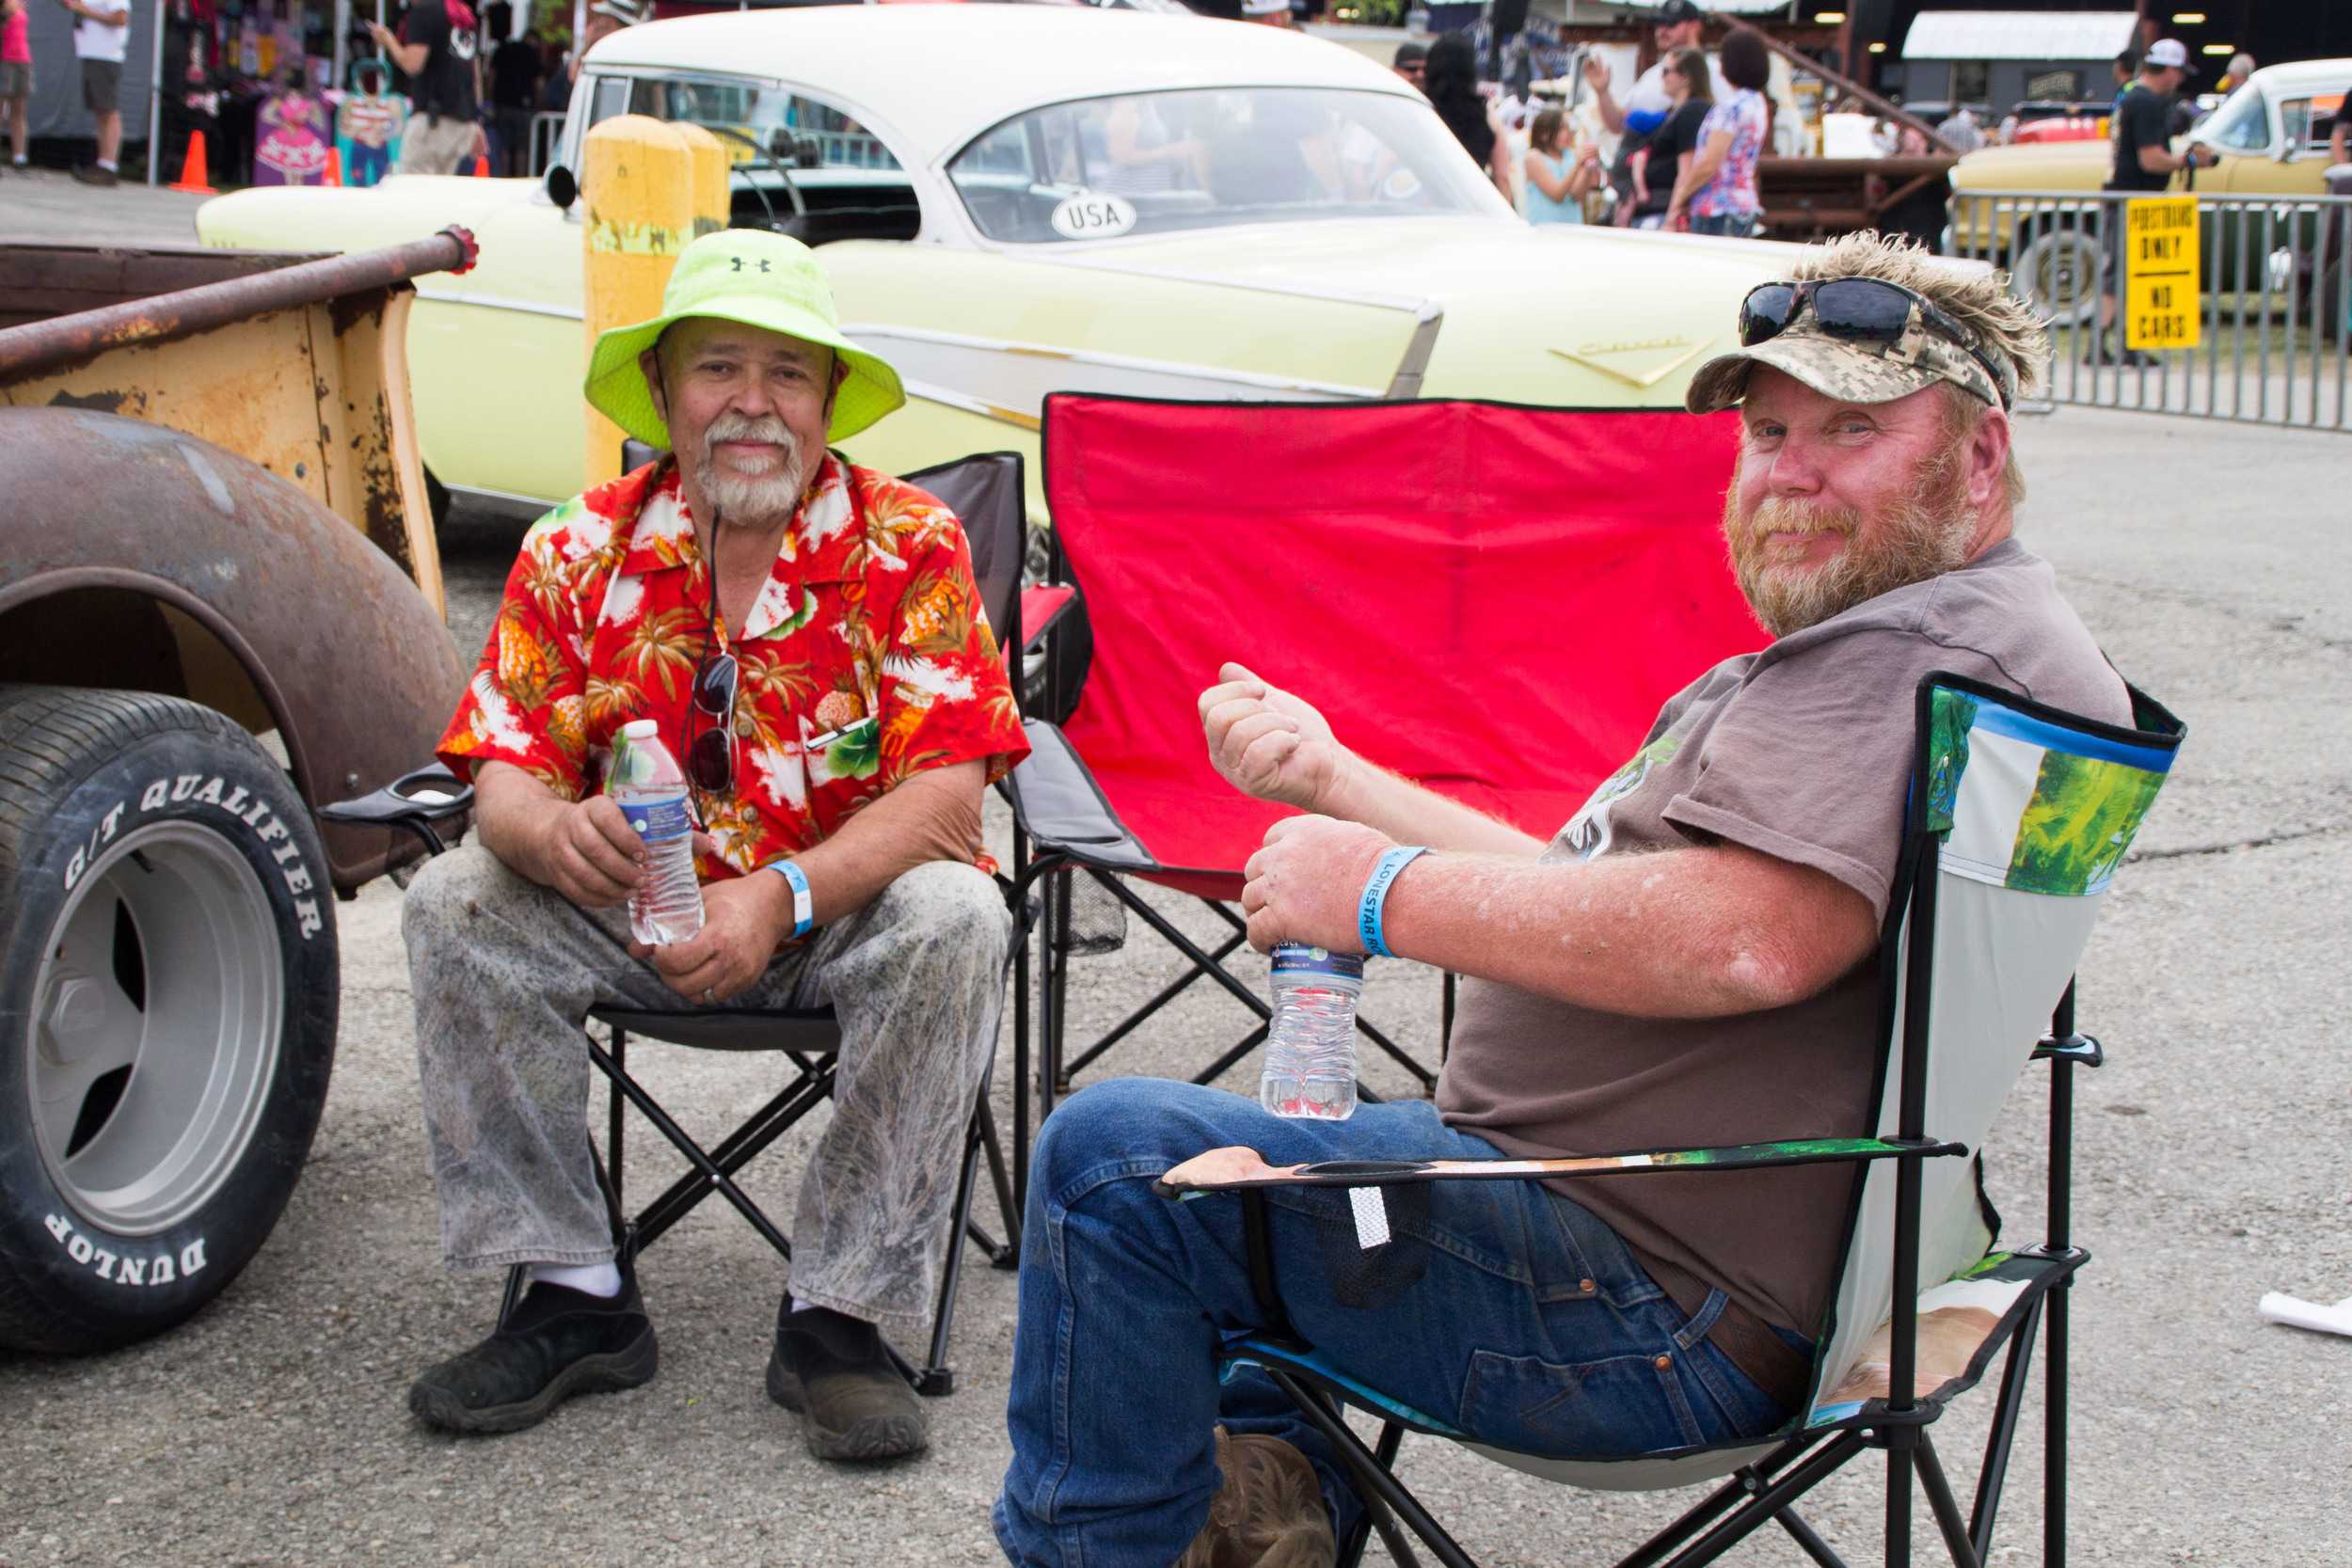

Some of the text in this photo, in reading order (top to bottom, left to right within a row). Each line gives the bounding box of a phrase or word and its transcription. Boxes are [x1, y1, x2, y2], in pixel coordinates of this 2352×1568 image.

[1068, 202, 1122, 230] USA
[2139, 235, 2181, 260] ONLY
[2150, 286, 2171, 309] NO
[2137, 315, 2185, 340] CARS
[64, 773, 323, 941] G/T QUALIFIER
[1363, 863, 1396, 936] LONESTAR
[43, 1212, 208, 1287] DUNLOP
